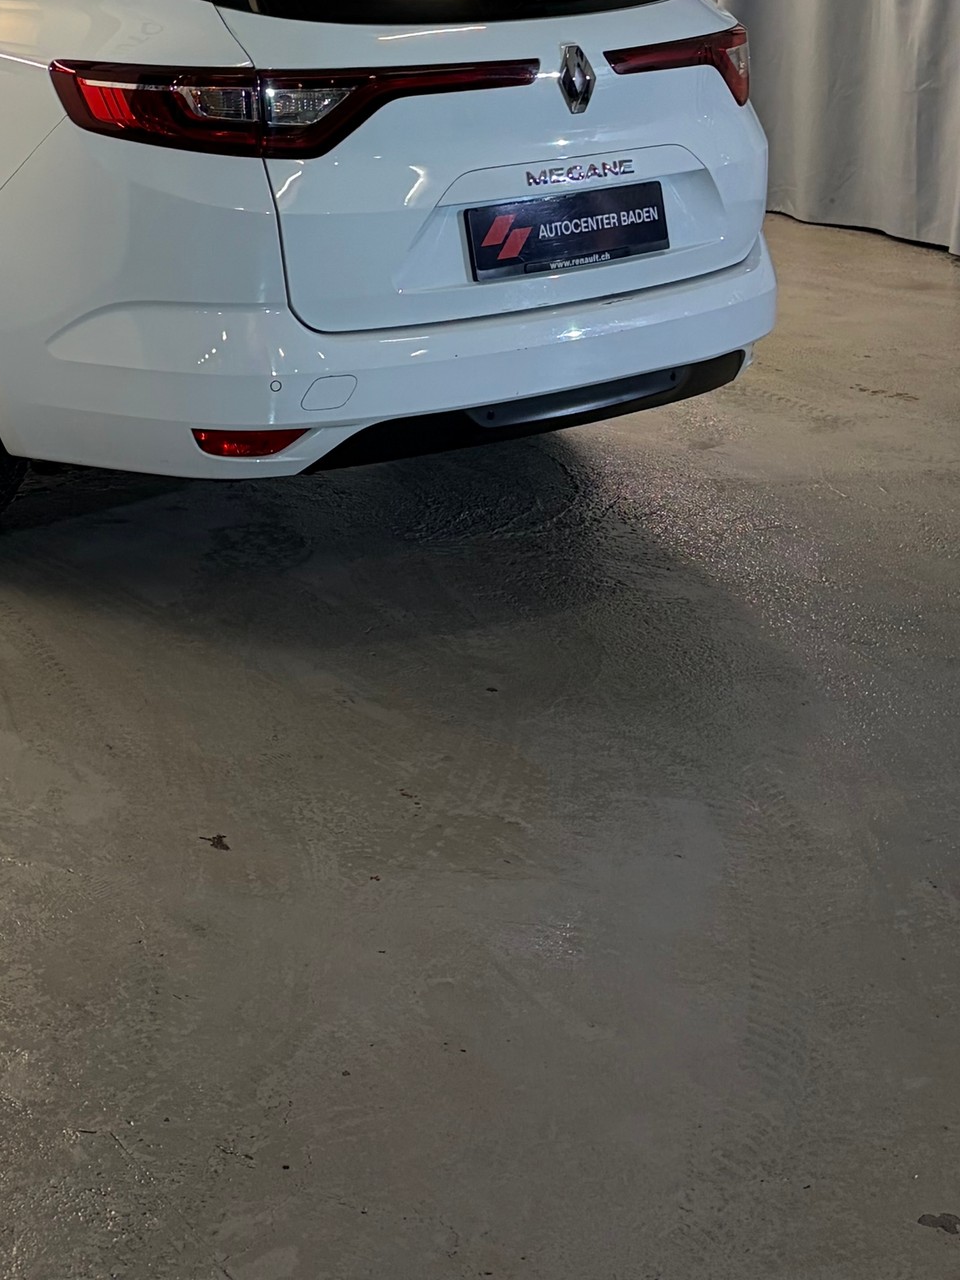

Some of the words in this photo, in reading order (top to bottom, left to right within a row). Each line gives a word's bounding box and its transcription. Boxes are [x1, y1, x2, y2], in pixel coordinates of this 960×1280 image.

[526, 159, 635, 186] MEGANE
[539, 213, 618, 239] AUTOCENTER
[620, 207, 658, 226] BADEN
[549, 252, 610, 269] www.renault.ch
